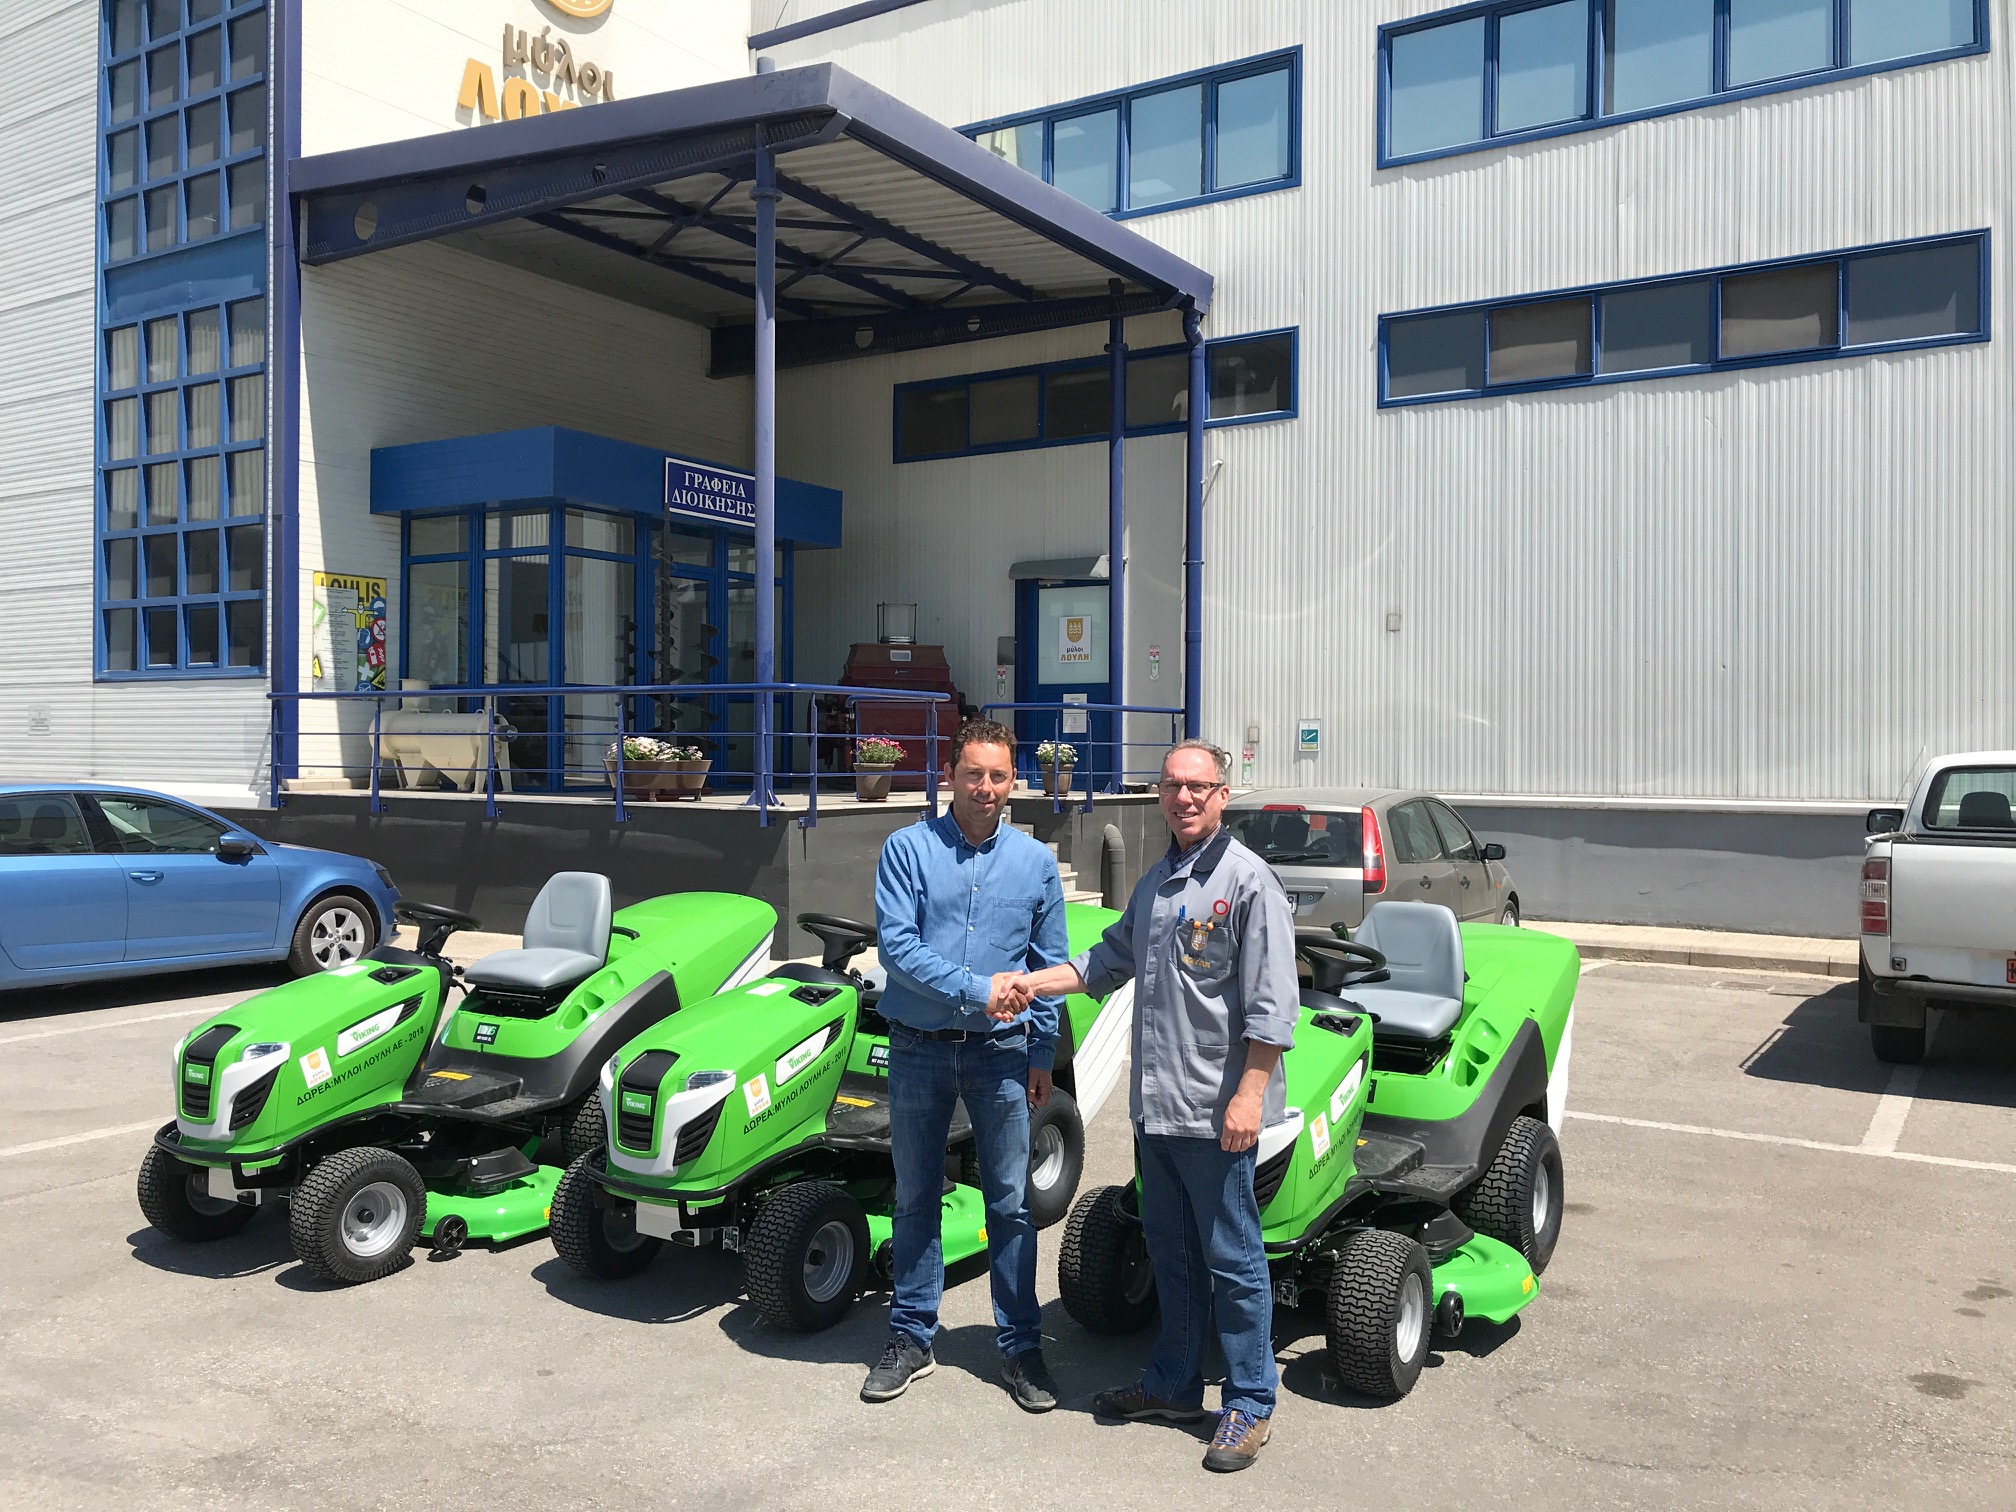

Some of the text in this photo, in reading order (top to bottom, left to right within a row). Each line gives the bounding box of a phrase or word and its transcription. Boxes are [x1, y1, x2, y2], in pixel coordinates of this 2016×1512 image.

[503, 23, 615, 101] μύλοι
[457, 57, 579, 121] ΛΟ
[684, 471, 746, 498] ΓΡΑΦΕΙΑ
[671, 488, 756, 518] ΔΙΟΙΚΗΣΗΣ
[1060, 653, 1089, 661] ΛΟΥΛΗ
[351, 1023, 380, 1042] VIKING
[363, 1046, 391, 1069] ΛΟΥΛΗ
[392, 1039, 403, 1052] ΑΕ
[788, 1048, 812, 1070] VIKING
[799, 1069, 822, 1095] ΛΟΥΛΗ
[822, 1061, 831, 1075] ΑΕ
[626, 1099, 646, 1110] VIKING
